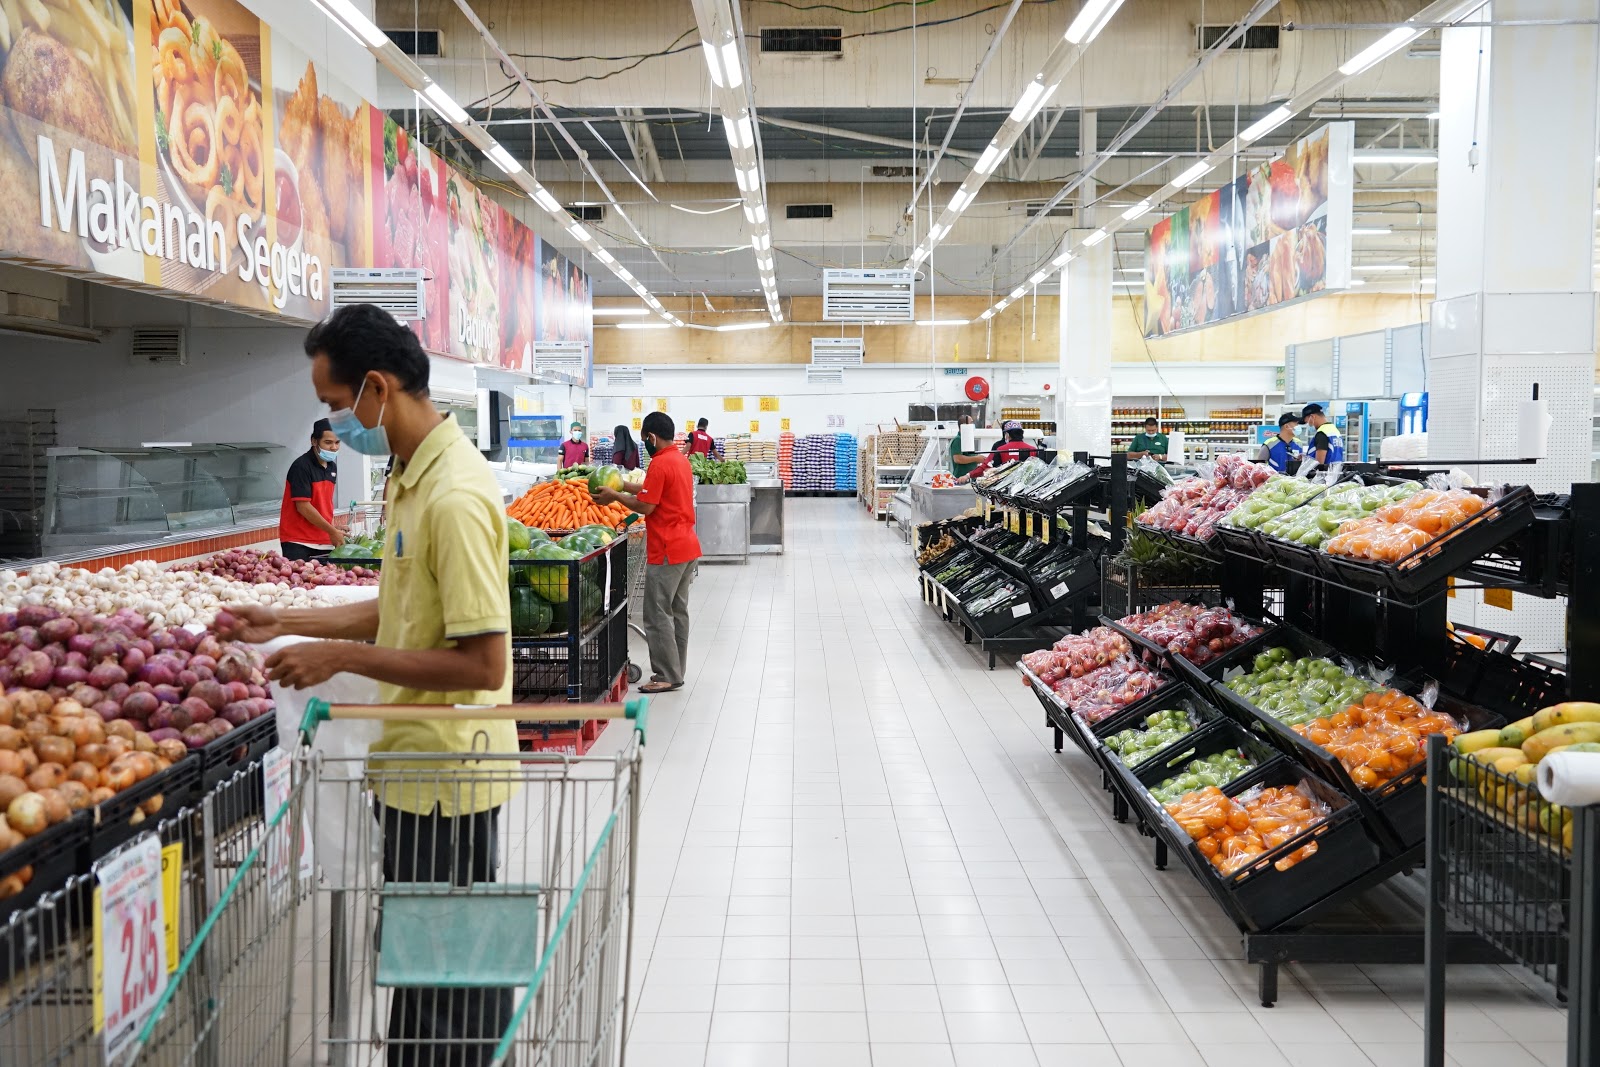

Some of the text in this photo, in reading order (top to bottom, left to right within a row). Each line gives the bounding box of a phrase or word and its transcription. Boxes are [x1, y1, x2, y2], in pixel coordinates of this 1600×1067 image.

[37, 134, 324, 309] Makanan Segera
[458, 302, 493, 362] Daging
[121, 899, 159, 1017] 2.95
